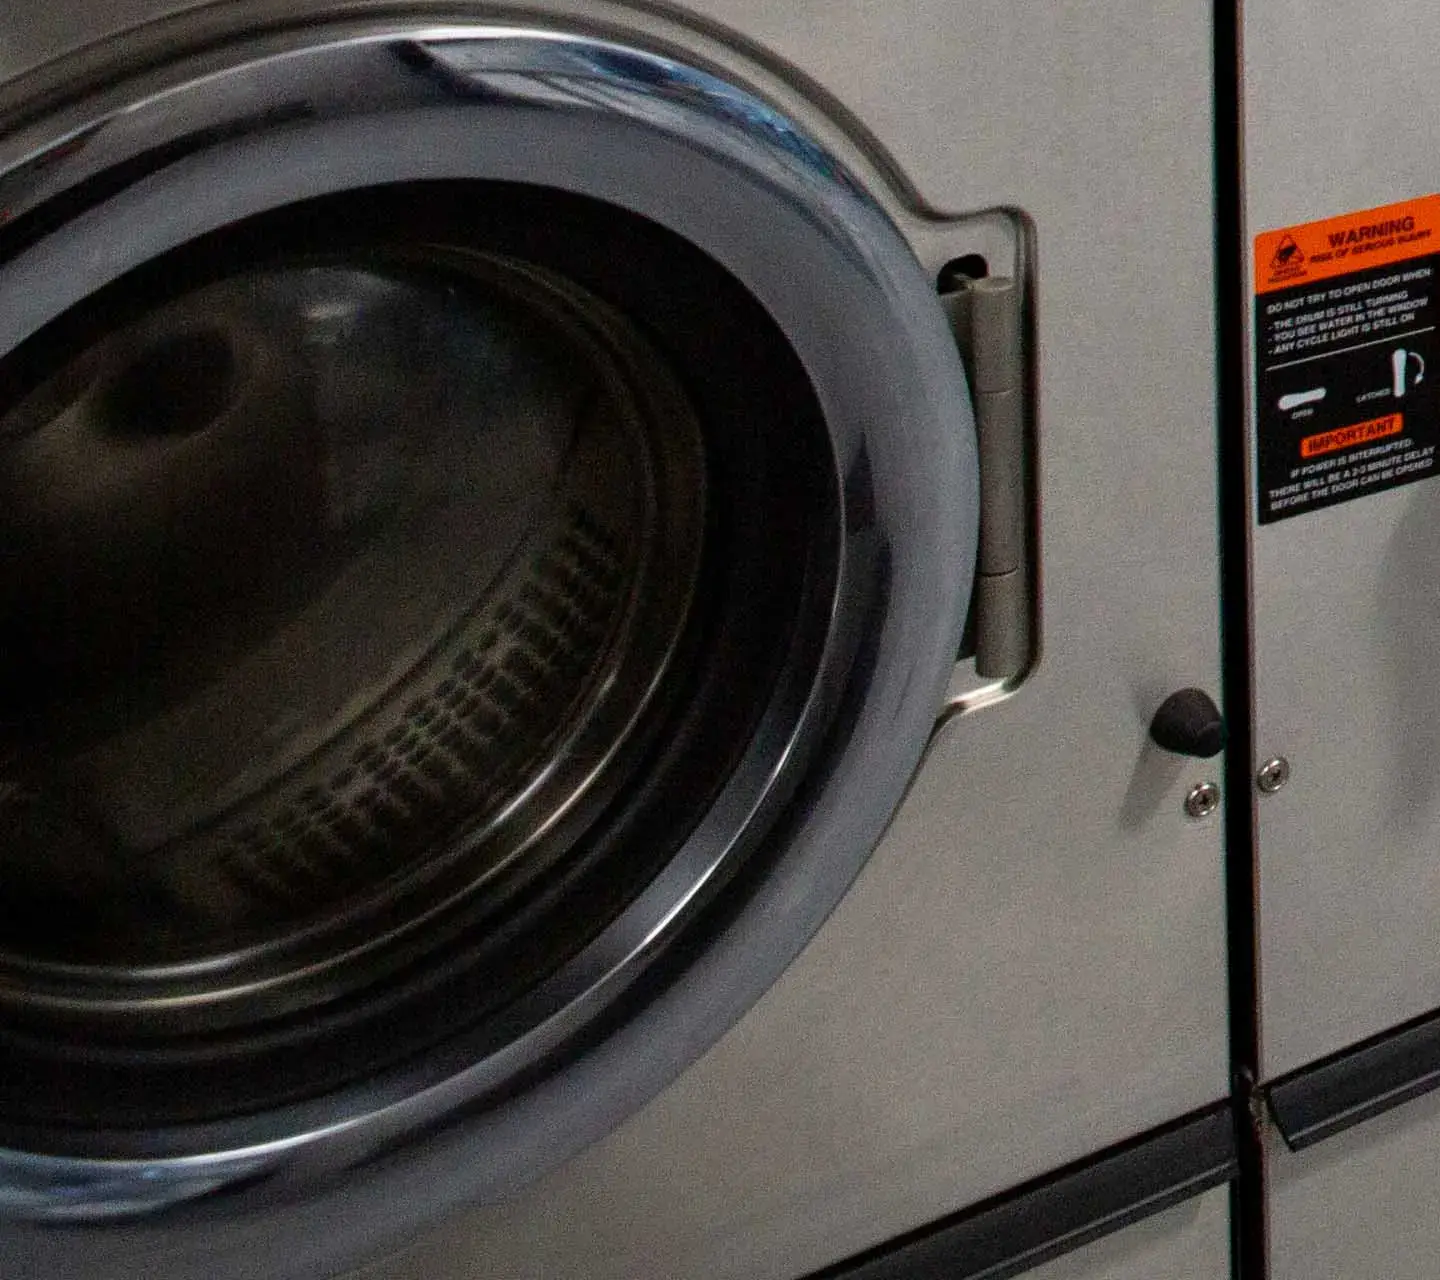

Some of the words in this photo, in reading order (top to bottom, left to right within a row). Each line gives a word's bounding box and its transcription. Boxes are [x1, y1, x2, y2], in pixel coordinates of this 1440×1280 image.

[1328, 216, 1414, 247] WARNING
[1267, 303, 1282, 315] DO
[1284, 298, 1305, 310] NOT
[1307, 294, 1327, 305] TRY
[1329, 290, 1342, 300] TO
[1343, 283, 1371, 297] OPEN
[1372, 276, 1400, 290] DOOR
[1274, 319, 1294, 330] THE
[1296, 312, 1325, 325] DRUM
[1327, 309, 1335, 317] IS
[1337, 302, 1364, 315] STILL
[1366, 290, 1408, 308] TURNING
[1274, 344, 1295, 355] ANY
[1297, 334, 1328, 348] CYCLE
[1331, 326, 1359, 340] LIGHT
[1362, 323, 1371, 332] IS
[1372, 317, 1398, 330] STILL
[1401, 313, 1415, 322] ON
[1275, 331, 1296, 342] YOU
[1297, 327, 1317, 338] SEE
[1319, 319, 1354, 332] WATER
[1368, 309, 1386, 320] THE
[1388, 298, 1428, 313] WINDOW
[1308, 419, 1394, 453] IMPORTANT
[1269, 487, 1300, 498] THERE
[1303, 480, 1326, 490] WILL
[1328, 475, 1341, 483] BE
[1368, 457, 1402, 472] MINUTE
[1404, 446, 1436, 461] DELAY
[1271, 495, 1310, 510] BEFORE
[1311, 488, 1328, 500] THE
[1332, 480, 1359, 493] DOOR
[1360, 475, 1380, 485] CAN
[1382, 469, 1394, 479] BE
[1395, 460, 1433, 475] OPENED
[1302, 460, 1336, 474] POWER
[1338, 457, 1346, 465] IS
